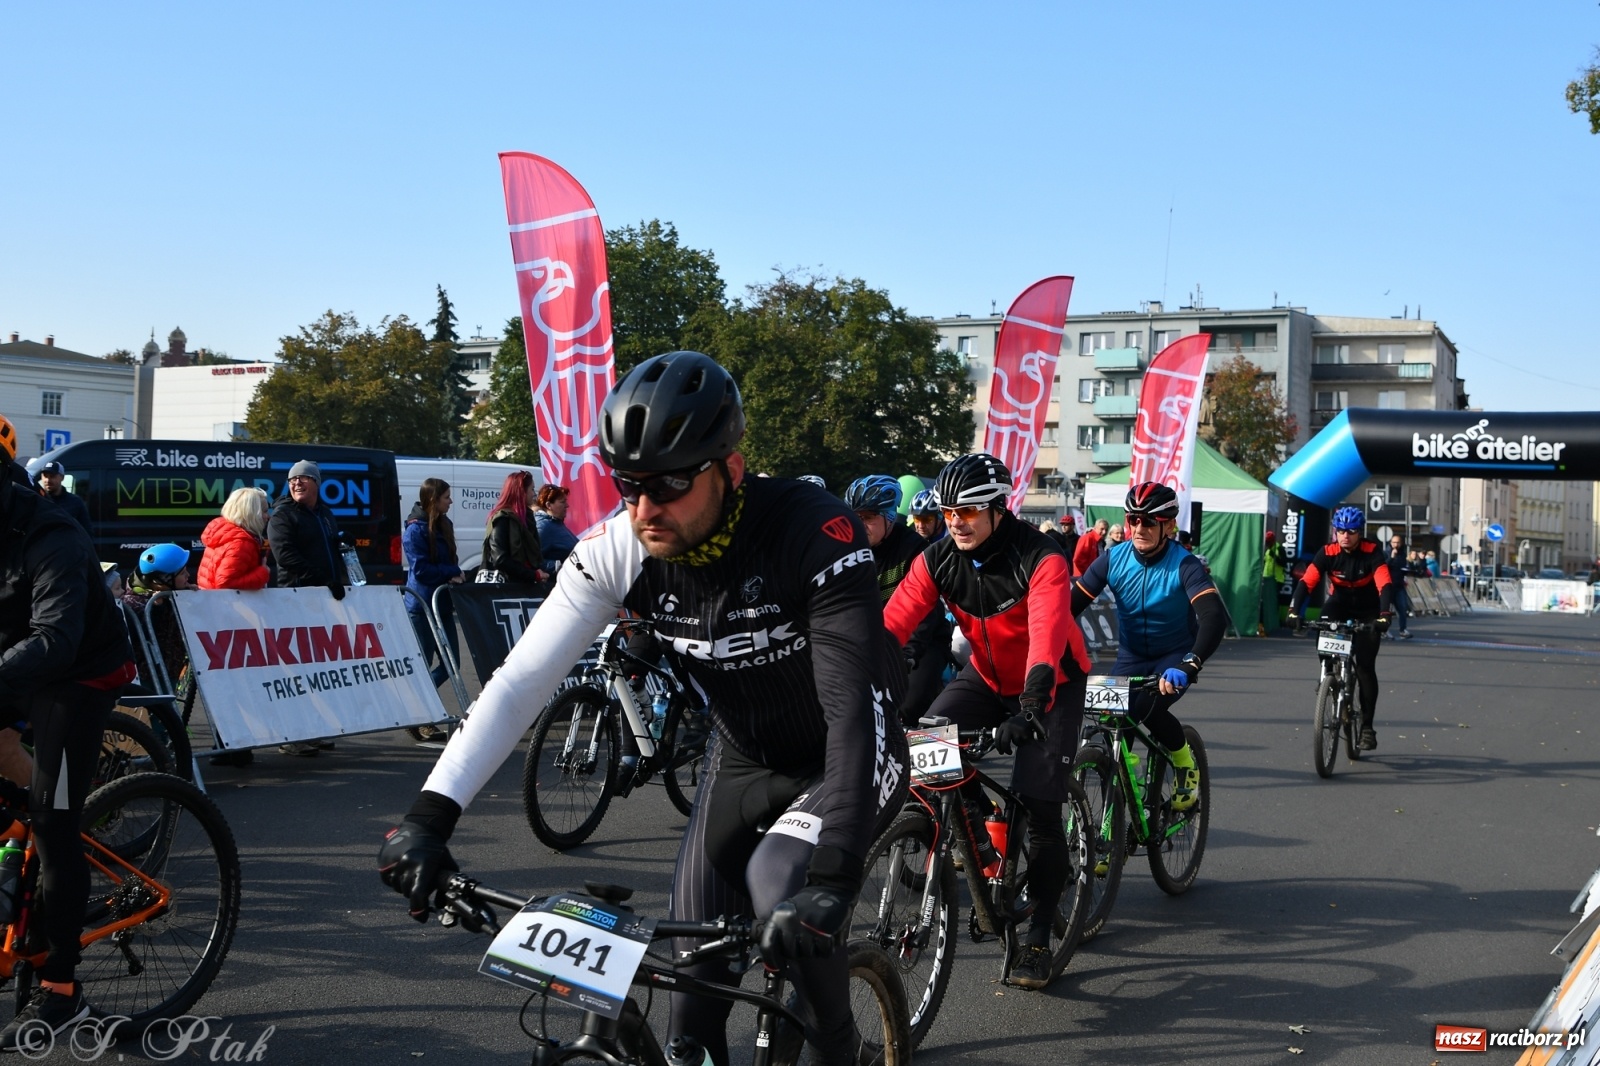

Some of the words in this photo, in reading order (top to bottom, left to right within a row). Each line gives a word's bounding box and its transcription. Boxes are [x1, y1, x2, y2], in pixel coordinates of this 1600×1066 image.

[156, 449, 198, 467] bike
[203, 451, 265, 469] atelier
[1412, 432, 1469, 459] bike
[1476, 435, 1566, 461] atelier
[1282, 508, 1299, 559] atelier
[810, 548, 875, 587] TRE
[727, 603, 781, 622] SHIMANO
[196, 623, 385, 670] YAKIMA
[654, 620, 798, 661] TREK
[723, 636, 807, 671] RACING
[1323, 641, 1346, 652] 2724
[262, 675, 304, 702] TAKE
[305, 665, 352, 694] MORE
[354, 656, 414, 684] FRIENDS
[1086, 690, 1120, 704] 3144
[518, 922, 613, 976] 1041
